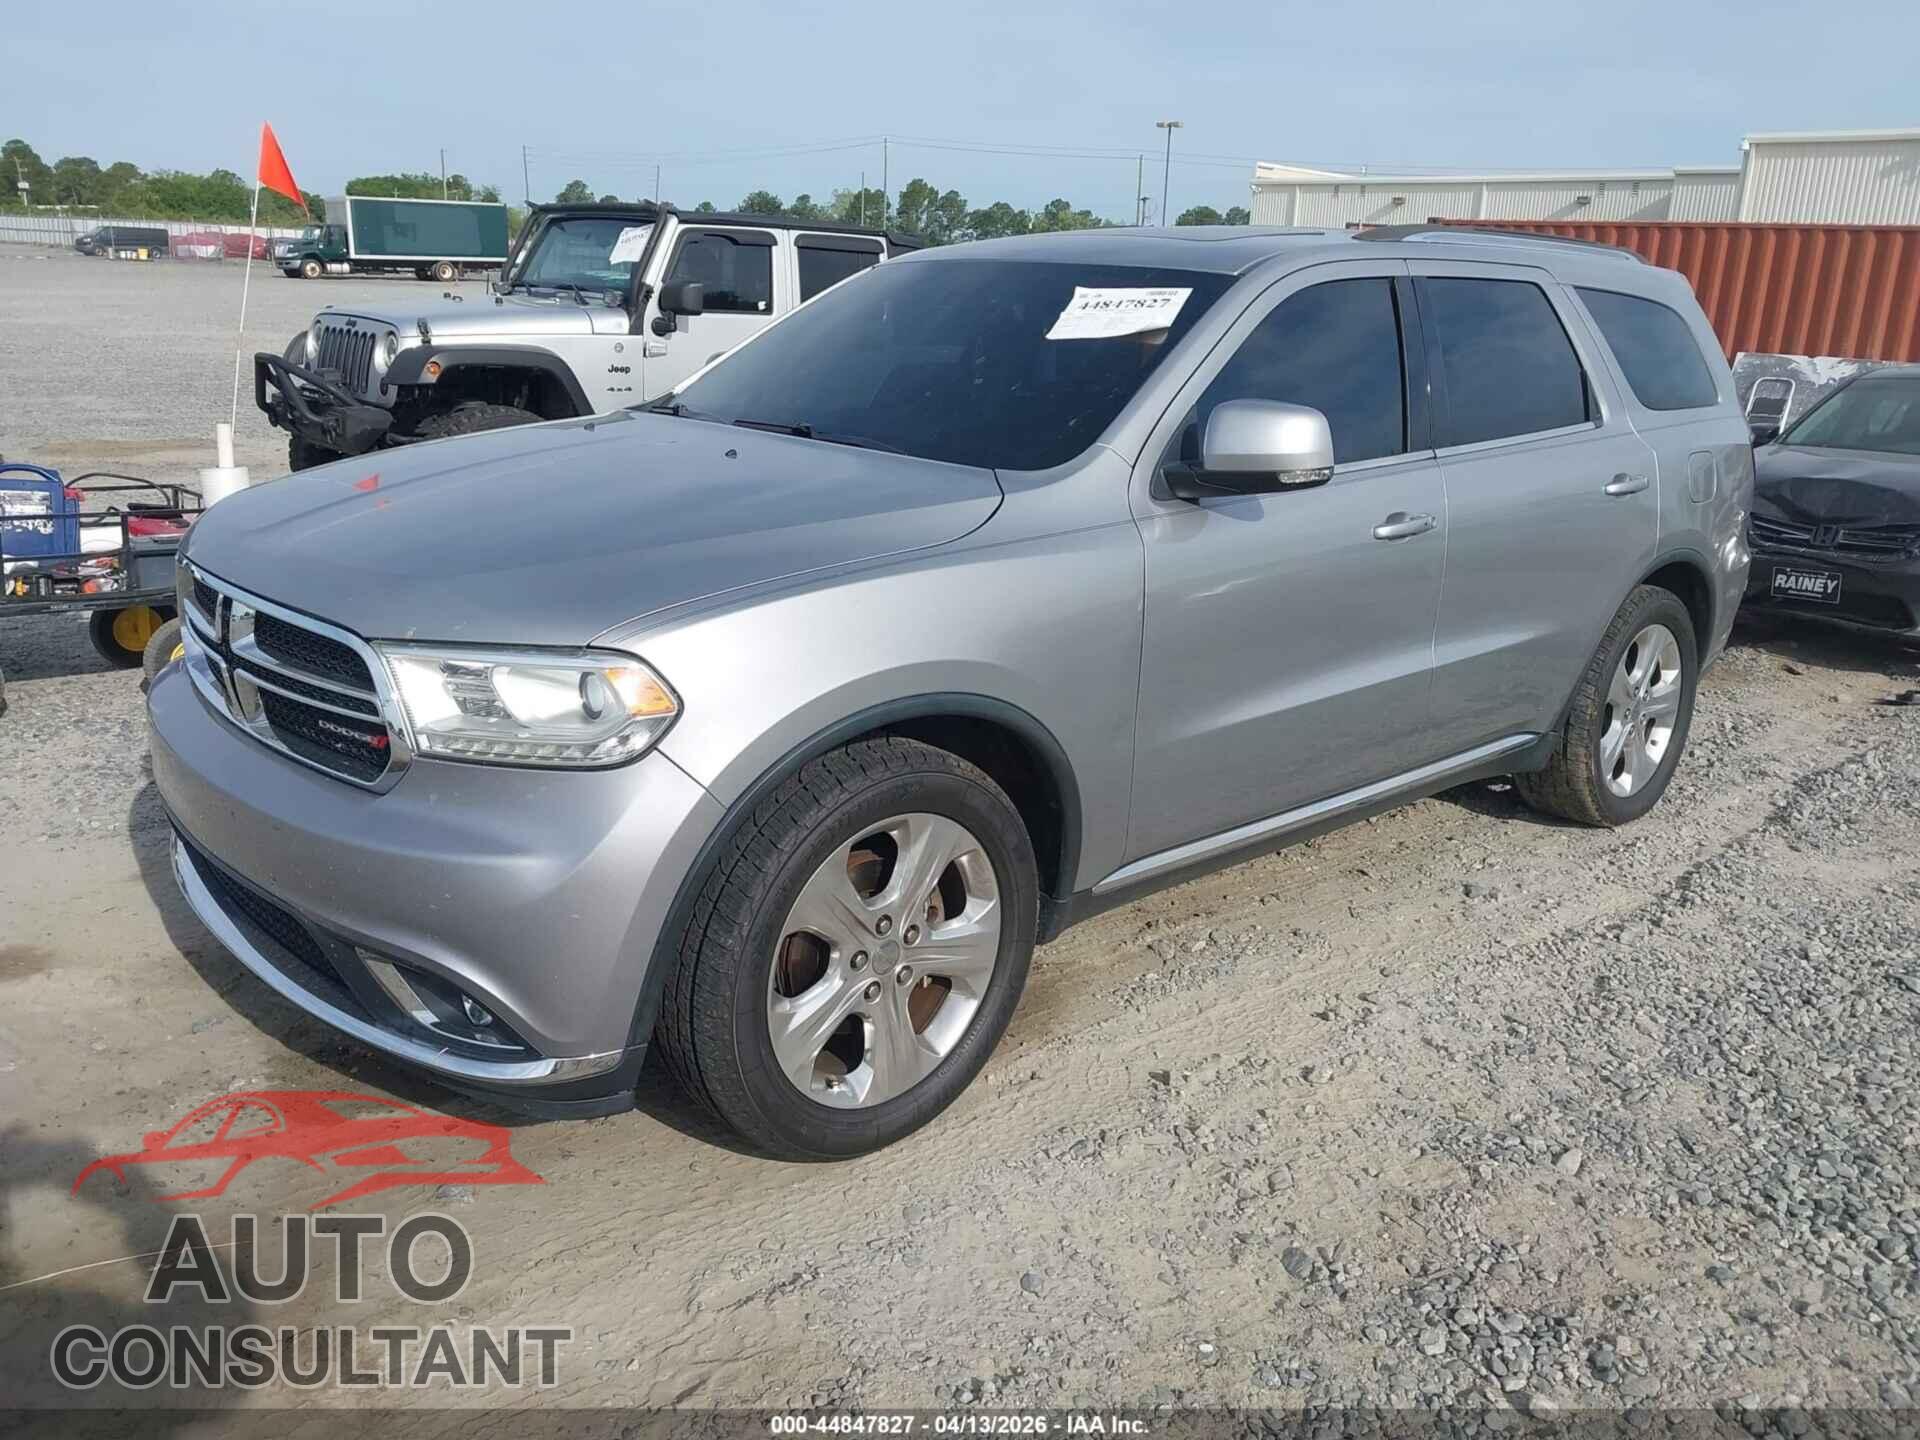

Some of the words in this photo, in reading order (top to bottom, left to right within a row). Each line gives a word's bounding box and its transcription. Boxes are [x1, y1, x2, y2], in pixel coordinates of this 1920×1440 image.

[1078, 298, 1171, 311] 44847827
[607, 364, 631, 375] Jeep
[1774, 574, 1838, 594] RAINEY
